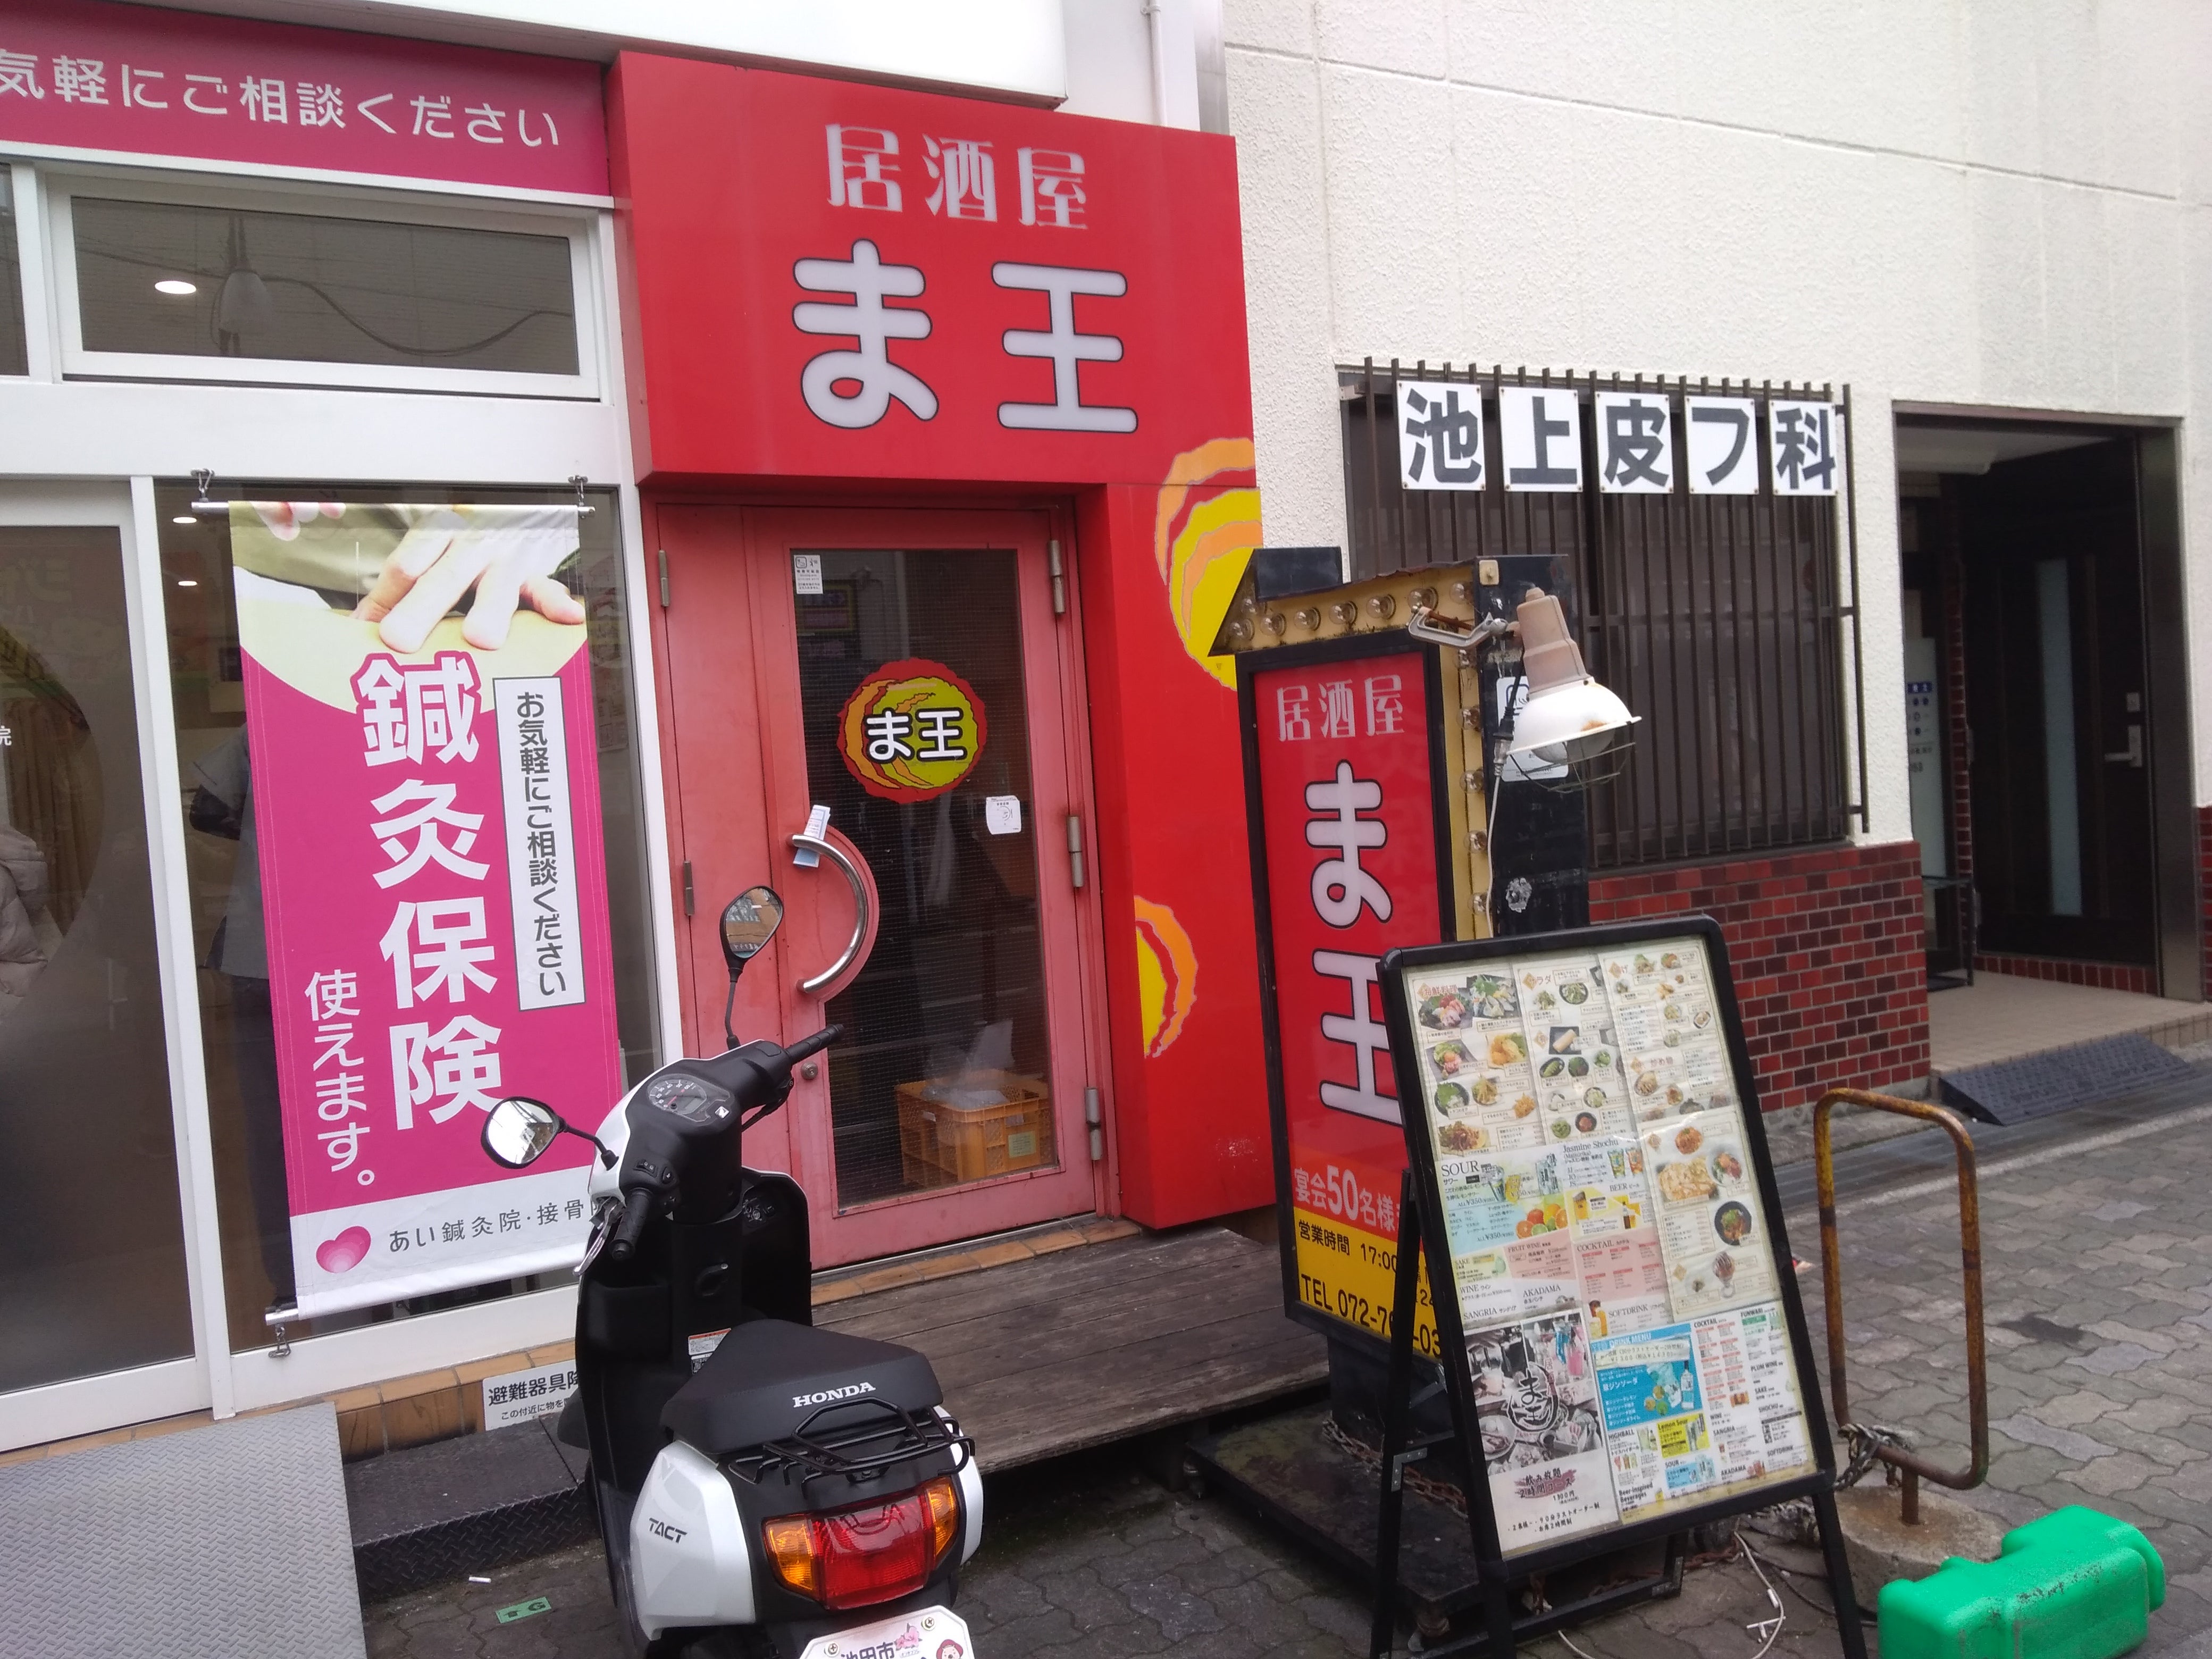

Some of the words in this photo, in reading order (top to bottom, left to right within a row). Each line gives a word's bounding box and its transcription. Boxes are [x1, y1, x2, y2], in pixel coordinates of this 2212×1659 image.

[825, 123, 1088, 230] 居酒屋
[792, 238, 1138, 433] ま王
[1405, 389, 1837, 490] 池上皮フ科
[1276, 674, 1405, 742] 居酒屋
[865, 708, 967, 763] ま王
[516, 692, 566, 996] お気軽にご相談ください
[356, 655, 502, 1131] 鍼灸保険
[304, 969, 375, 1186] 使えます。
[1563, 1143, 1591, 1153] Jasmine
[1593, 1138, 1619, 1149] Shochu
[1441, 1160, 1479, 1177] SOUR
[1609, 1183, 1628, 1192] BEER
[1294, 1164, 1401, 1232] 宴会50名様
[1299, 1219, 1350, 1256] 営業時間
[1577, 1240, 1614, 1252] COCKTAIL
[1301, 1273, 1333, 1311] TEL
[1460, 1284, 1479, 1294] WINE
[1523, 1284, 1562, 1297] AKADAMA
[1463, 1308, 1497, 1320] SANGRIA
[1608, 1304, 1648, 1319] SOFTDRINK
[1694, 1319, 1718, 1328] COCKTAIL
[1632, 1333, 1652, 1343] MENU
[792, 1382, 876, 1408] HONDA
[501, 1399, 568, 1420] この付近に物を
[1758, 1403, 1779, 1413] SHOCHU
[1608, 1429, 1635, 1439] HIGHBALL
[1657, 1421, 1676, 1431] Lemon
[1713, 1425, 1736, 1436] SANGRIA
[1767, 1445, 1794, 1457] SOFTDRINK
[1665, 1460, 1679, 1468] SOUR
[1721, 1464, 1747, 1477] AKADAMA
[1525, 1467, 1562, 1486] 飲み放題
[1519, 1478, 1573, 1498] 2時間コース
[1620, 1493, 1647, 1503] Beverages
[649, 1518, 688, 1544] TACT
